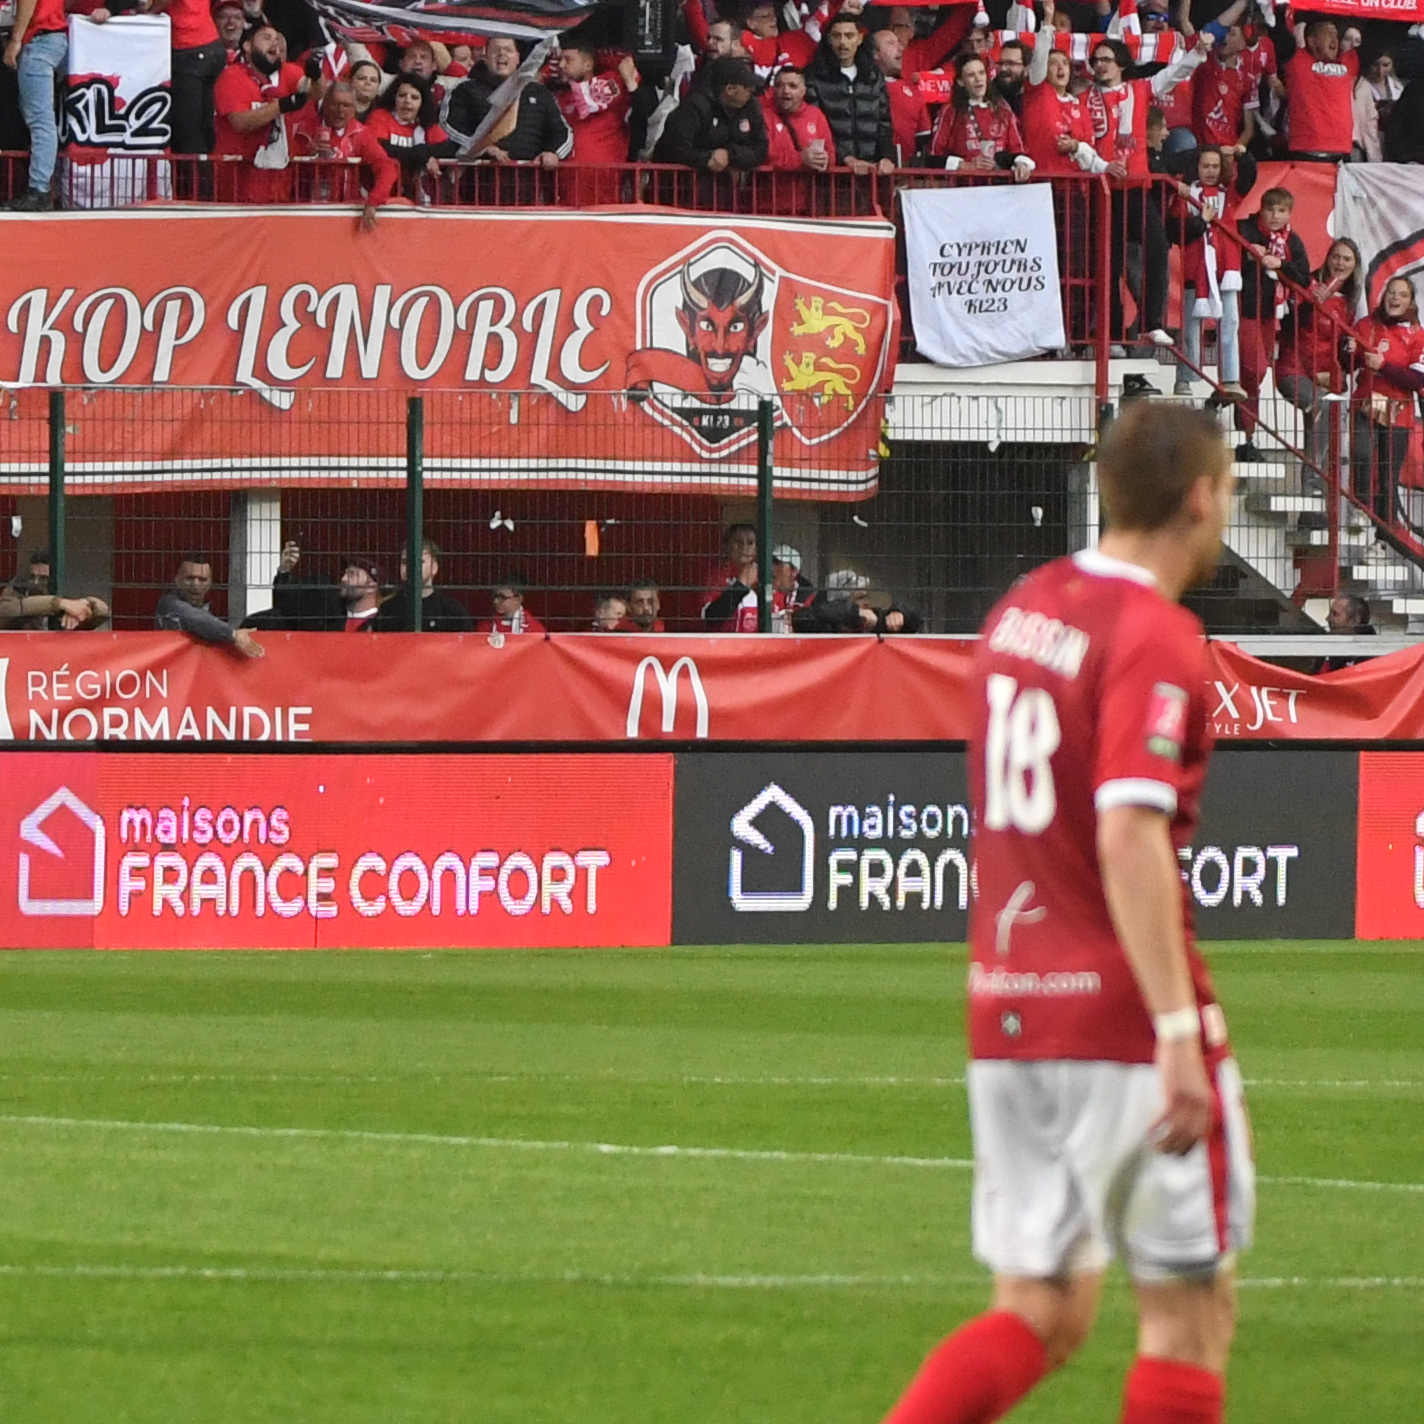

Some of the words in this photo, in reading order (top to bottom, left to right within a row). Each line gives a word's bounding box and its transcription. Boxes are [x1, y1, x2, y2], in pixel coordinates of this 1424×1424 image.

[928, 255, 1043, 280] TOUJOURS
[939, 237, 1028, 258] CYPRIEN
[930, 278, 980, 299] AVEC
[982, 274, 1046, 294] NOUS
[7, 284, 206, 385] KOP
[226, 282, 612, 412] LENOBLE
[28, 663, 169, 701] RÉGION
[29, 705, 314, 741] NORMANDIE
[1246, 686, 1309, 732] JET
[984, 672, 1062, 835] 18
[119, 796, 291, 845] maisons
[829, 793, 970, 840] maison
[118, 851, 339, 918] FRANCE
[350, 851, 612, 918] CONFORT
